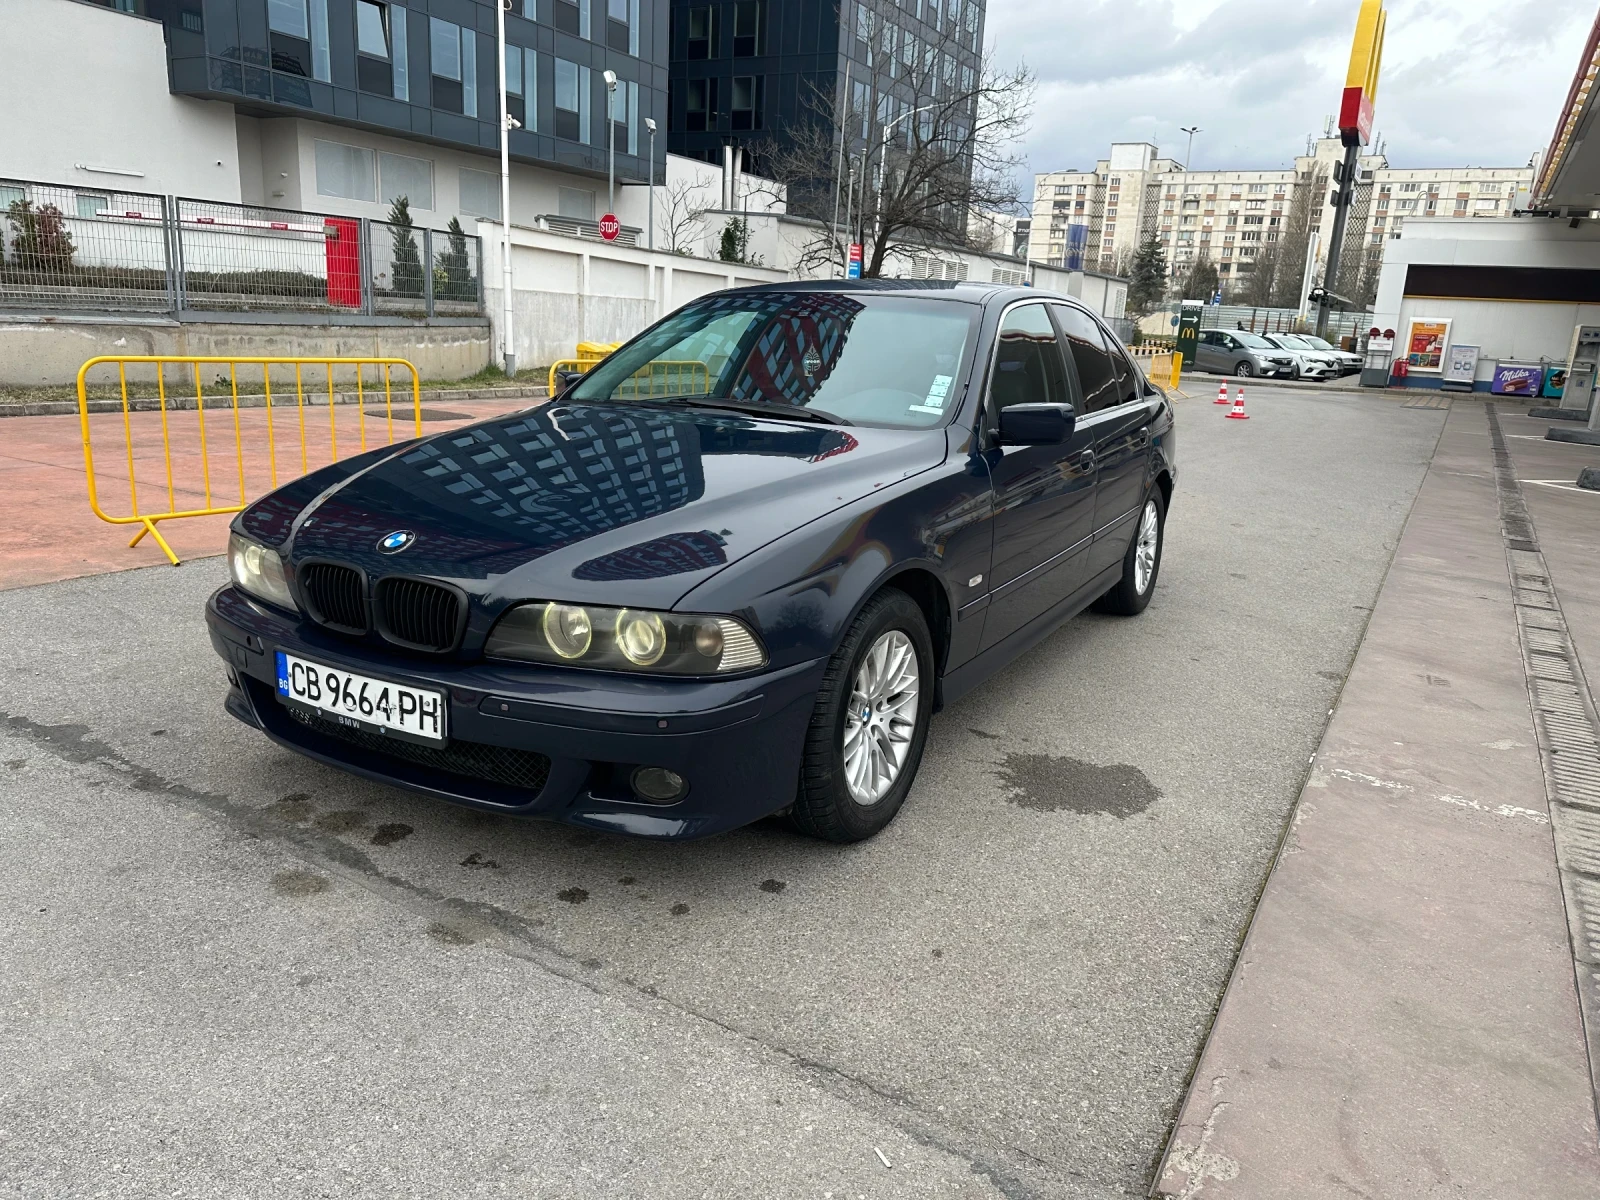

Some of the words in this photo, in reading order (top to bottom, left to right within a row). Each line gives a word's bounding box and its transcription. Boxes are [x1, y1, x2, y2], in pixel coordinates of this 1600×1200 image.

[600, 221, 618, 232] STOP
[1499, 369, 1530, 381] Milka
[278, 678, 289, 690] BG
[338, 716, 361, 729] BMW
